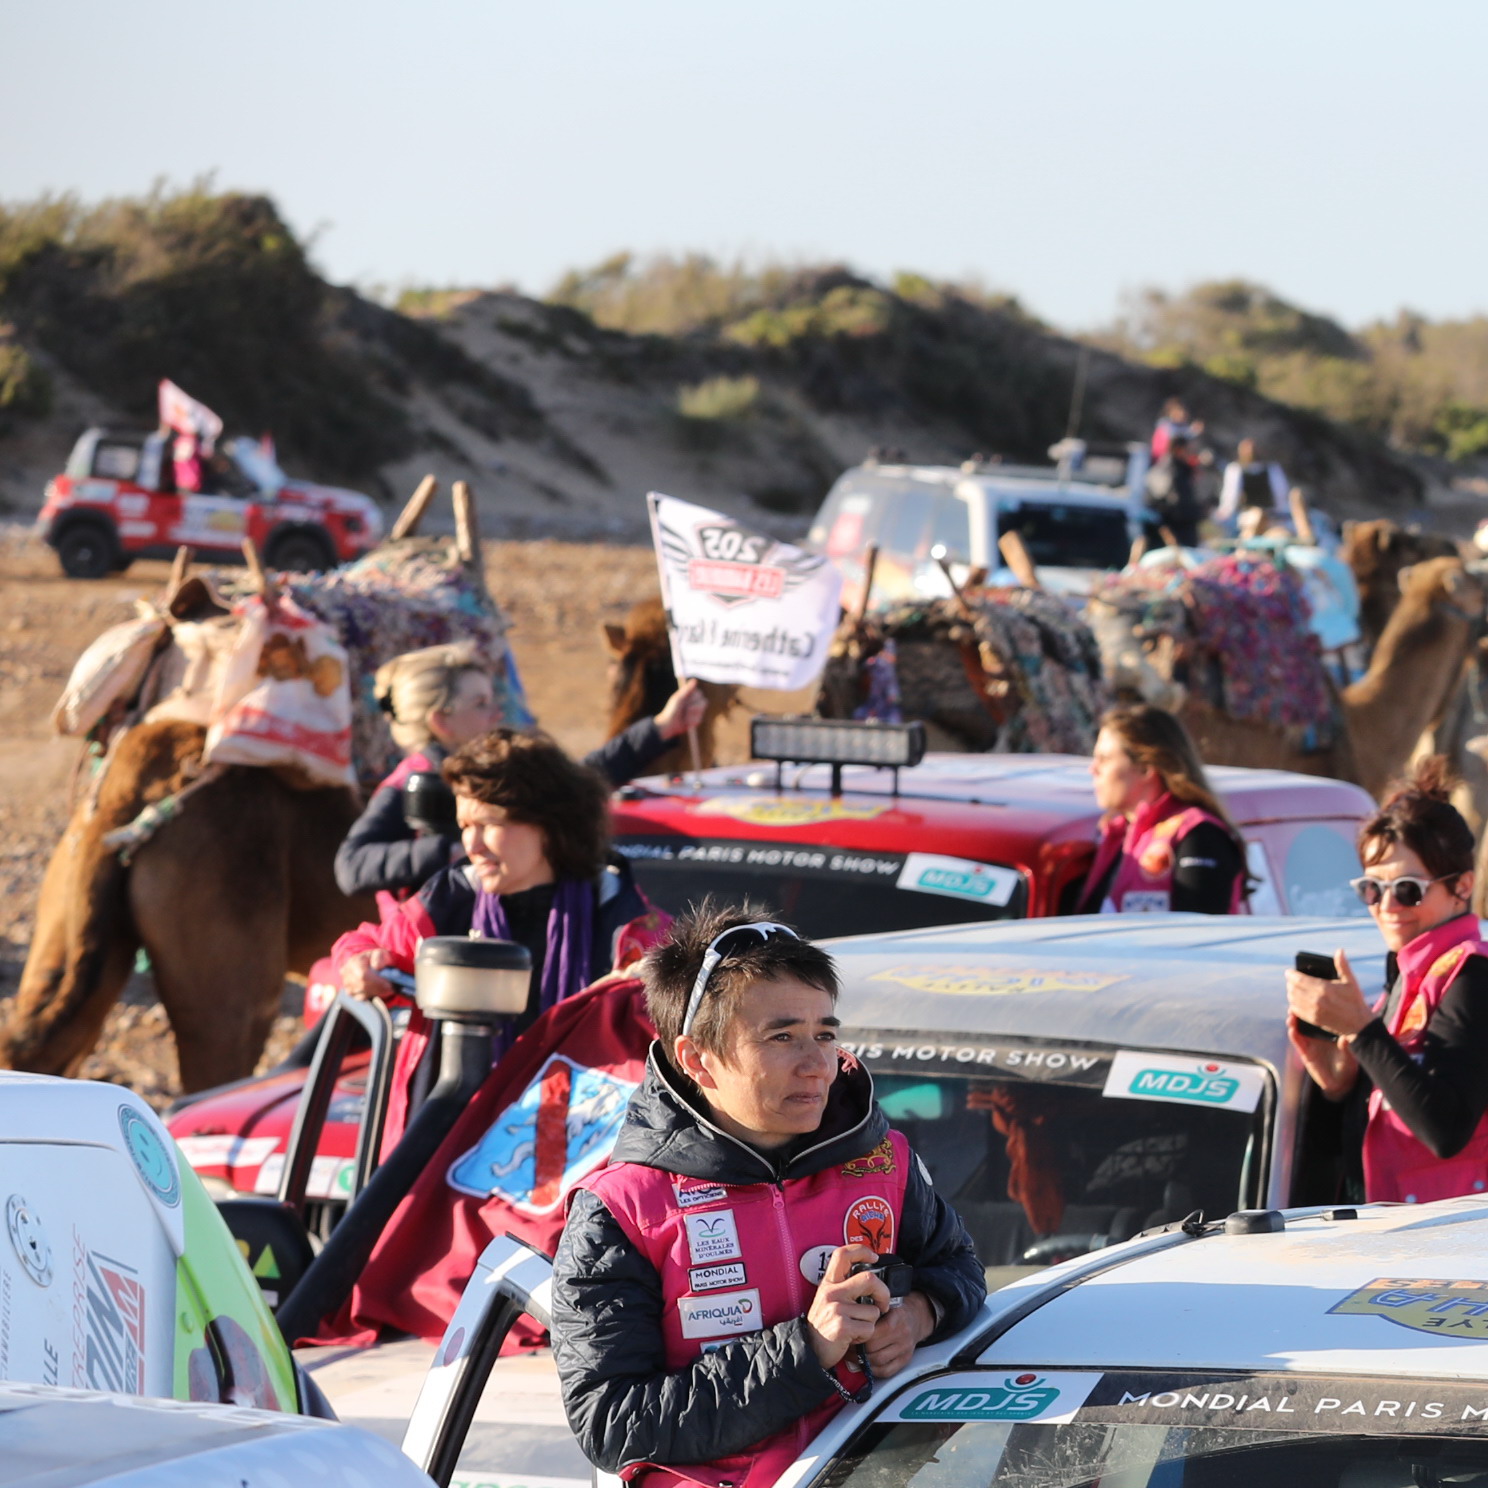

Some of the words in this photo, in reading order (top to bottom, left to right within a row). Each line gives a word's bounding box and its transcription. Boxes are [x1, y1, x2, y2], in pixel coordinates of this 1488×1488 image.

[611, 844, 673, 860] NDIAL
[678, 846, 743, 863] PARIS
[747, 849, 824, 869] MOTOR
[829, 854, 900, 876] SHOW
[892, 1045, 997, 1064] MOTOR
[1005, 1050, 1099, 1071] SHOW
[1138, 1071, 1235, 1098] MDJS
[852, 1201, 890, 1219] RALLYE
[695, 1267, 738, 1279] MONDIAL
[688, 1306, 742, 1320] AFRIQUIA
[915, 1393, 1047, 1411] MDJS
[1117, 1389, 1295, 1414] MONDIAL
[1314, 1396, 1445, 1420] PARIS
